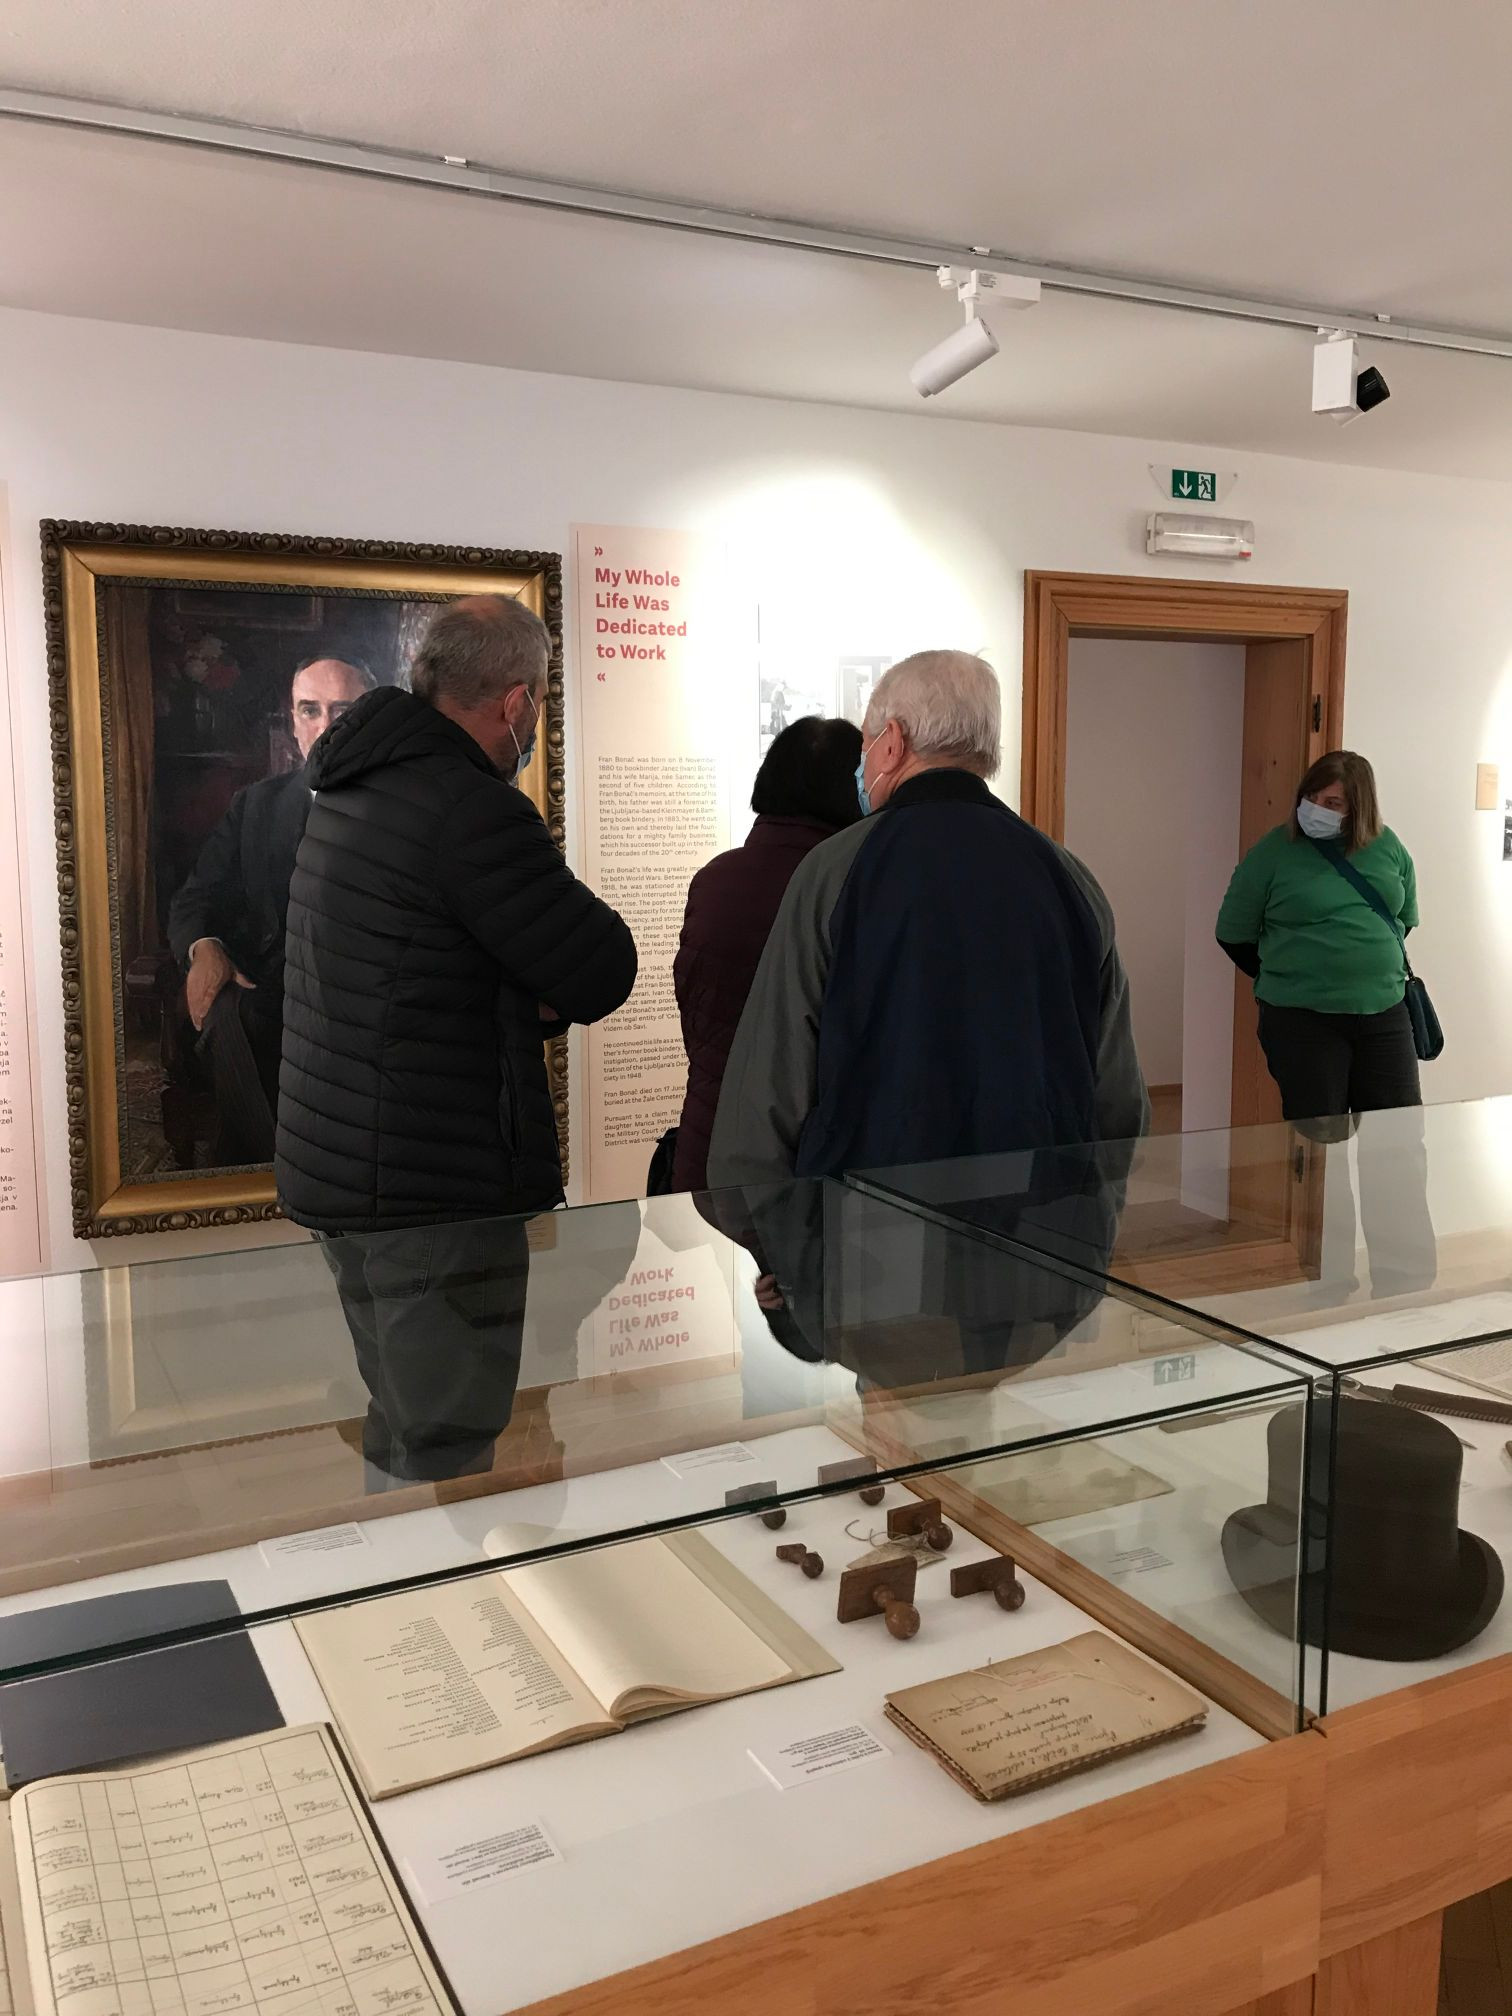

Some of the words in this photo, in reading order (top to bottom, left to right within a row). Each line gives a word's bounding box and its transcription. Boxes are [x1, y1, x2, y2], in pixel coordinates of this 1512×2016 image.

[595, 567, 621, 588] My
[624, 569, 680, 587] Whole
[595, 592, 629, 609] Life
[632, 594, 670, 611] Was
[596, 618, 687, 637] Dedicated
[596, 643, 616, 659] to
[620, 644, 667, 661] Work
[642, 891, 676, 899] interrupted
[644, 924, 663, 932] period
[651, 940, 674, 948] leading
[623, 1015, 637, 1024] legal
[638, 1014, 656, 1022] entity
[604, 1056, 638, 1066] instigation,
[640, 1054, 660, 1063] passed
[604, 1074, 619, 1082] ciety
[656, 1093, 684, 1102] Cemetery
[605, 1114, 632, 1122] Pursuant
[605, 1122, 632, 1131] daughter
[617, 1129, 639, 1138] Military
[605, 1138, 628, 1146] District
